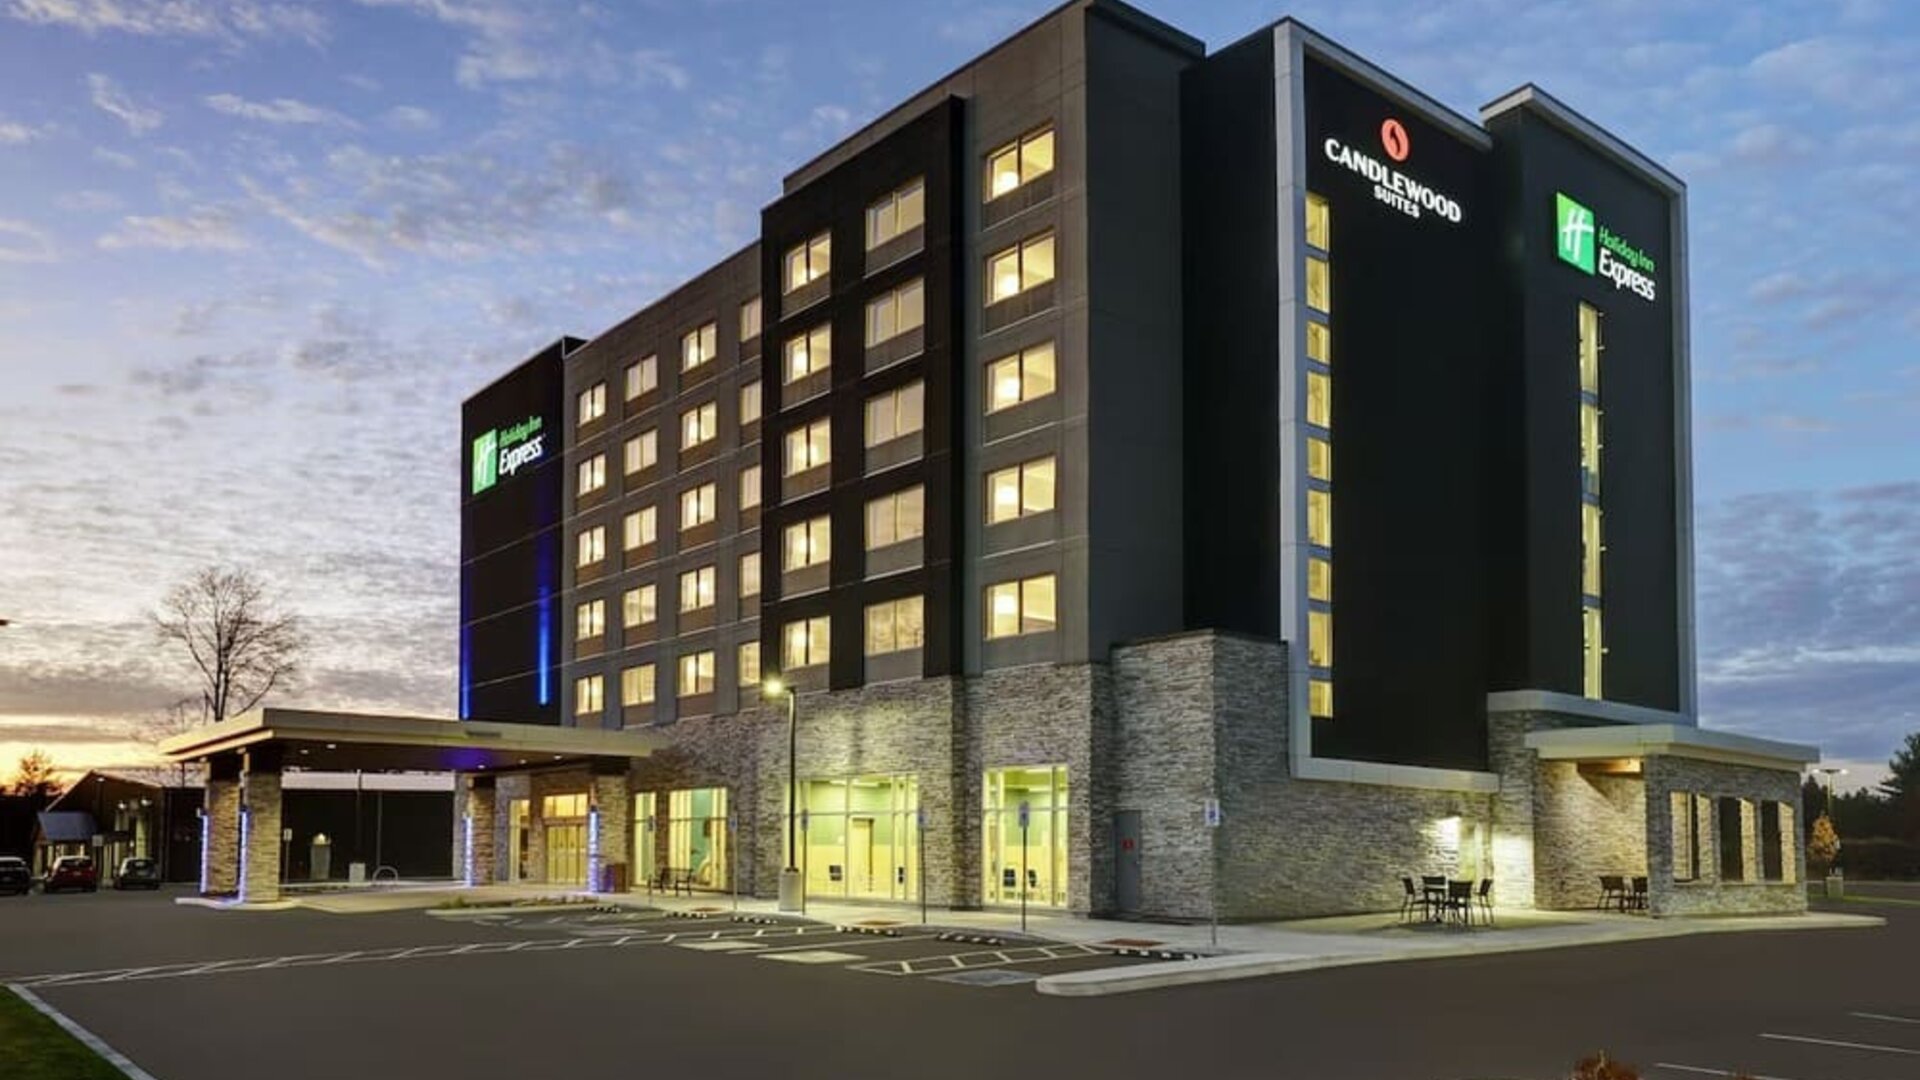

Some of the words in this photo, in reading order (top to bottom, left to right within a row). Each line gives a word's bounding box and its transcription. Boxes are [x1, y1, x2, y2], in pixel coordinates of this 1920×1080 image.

[1324, 138, 1462, 223] CANDLEWOOD
[1373, 184, 1420, 219] SUITES
[1599, 226, 1638, 268] Holiday
[1639, 249, 1655, 273] Inn
[1599, 246, 1656, 301] Express
[499, 435, 543, 476] Express
